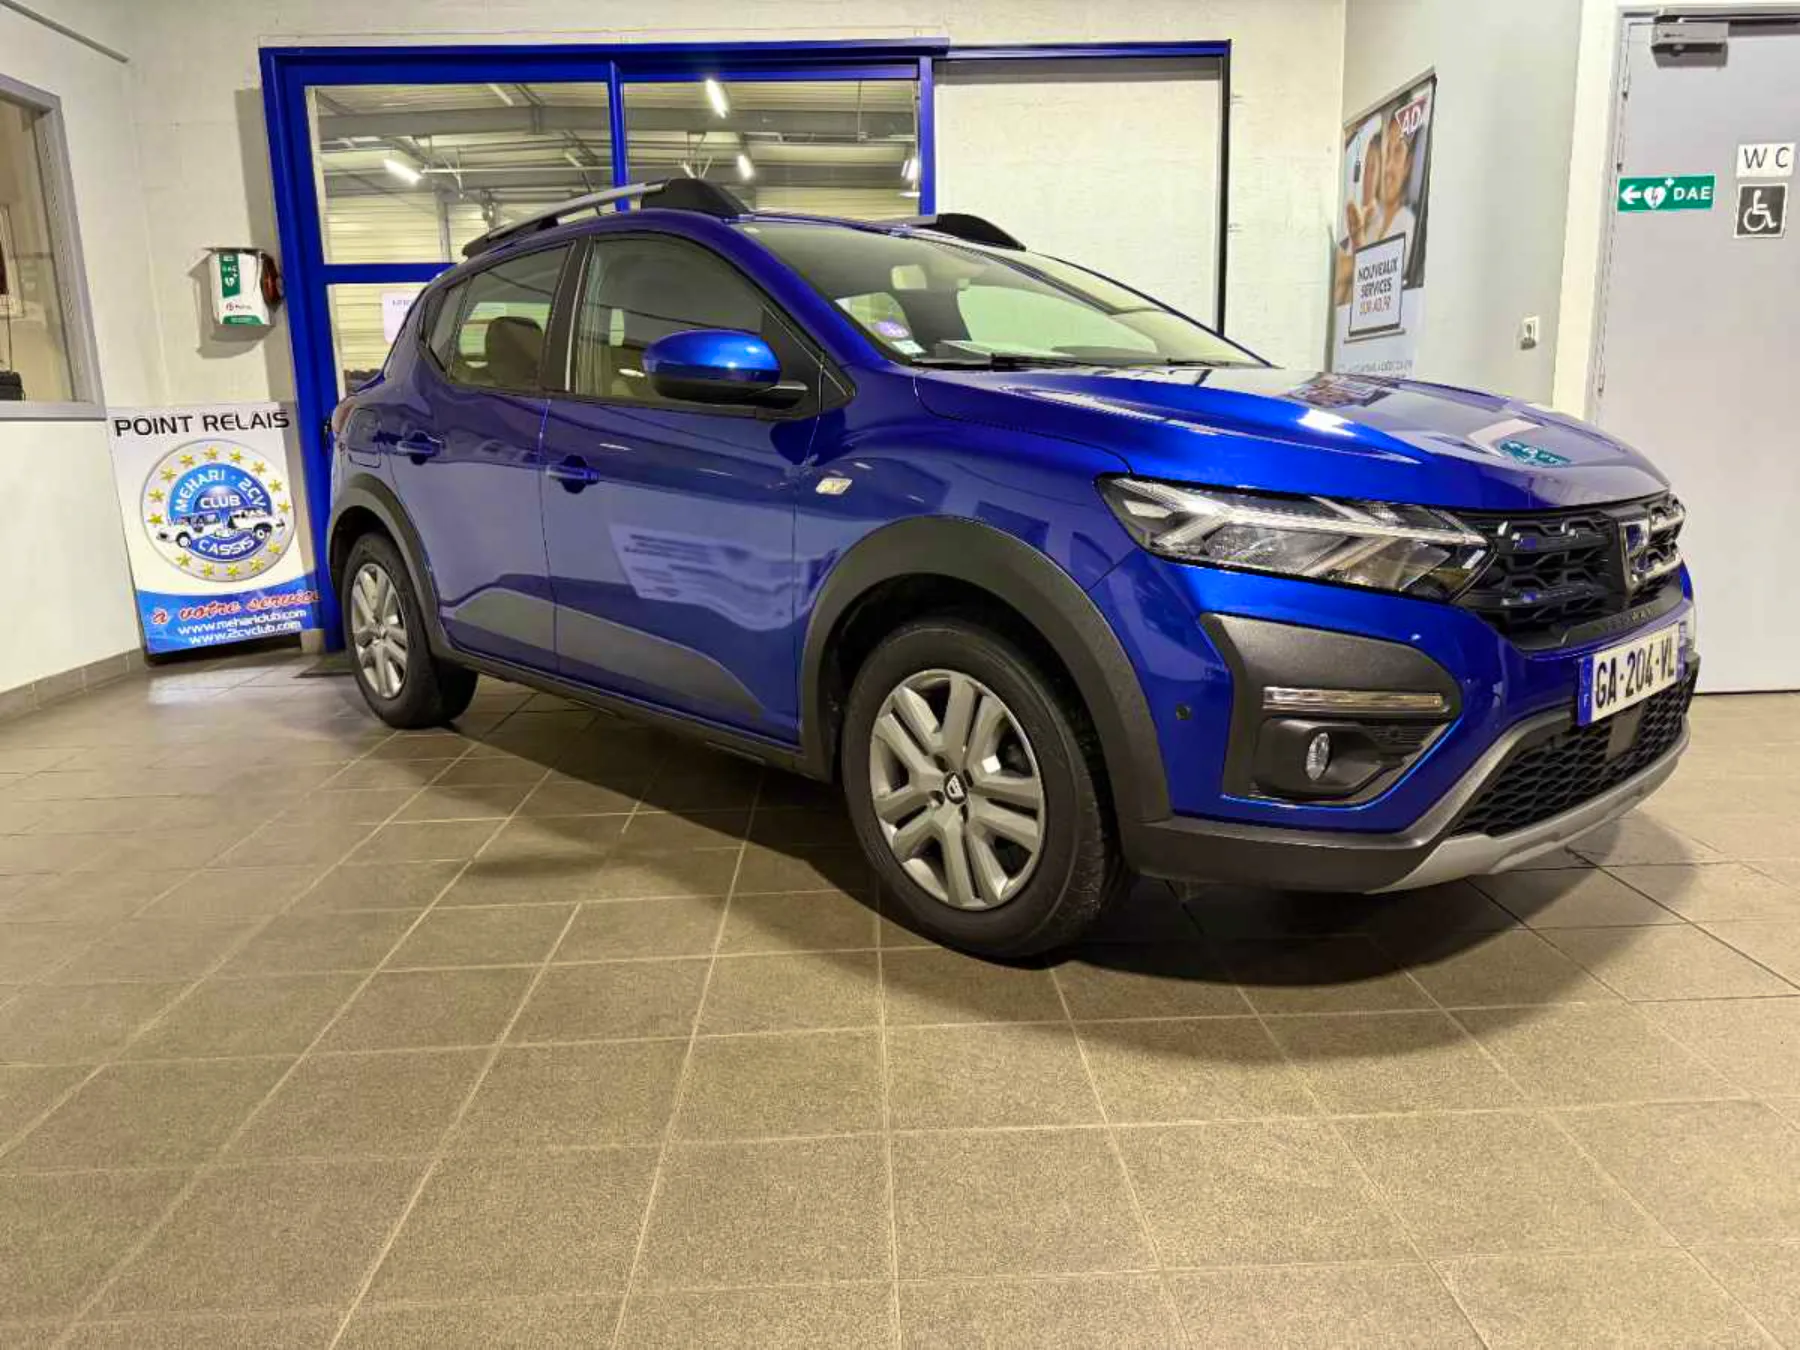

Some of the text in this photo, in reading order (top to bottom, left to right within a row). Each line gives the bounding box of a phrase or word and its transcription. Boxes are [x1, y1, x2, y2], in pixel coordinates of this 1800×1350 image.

[1674, 187, 1712, 201] DAE
[1358, 257, 1399, 282] NOUVEAUX
[1360, 277, 1393, 298] SERVICES
[115, 409, 291, 437] POINT RELAIS
[174, 469, 267, 513] MEHARI 2CV
[200, 494, 241, 508] CLUB
[198, 536, 255, 556] CASSIS
[180, 600, 241, 621] votre
[188, 620, 303, 645] www.2cvclub.com
[1596, 636, 1675, 709] GA-204-VL
